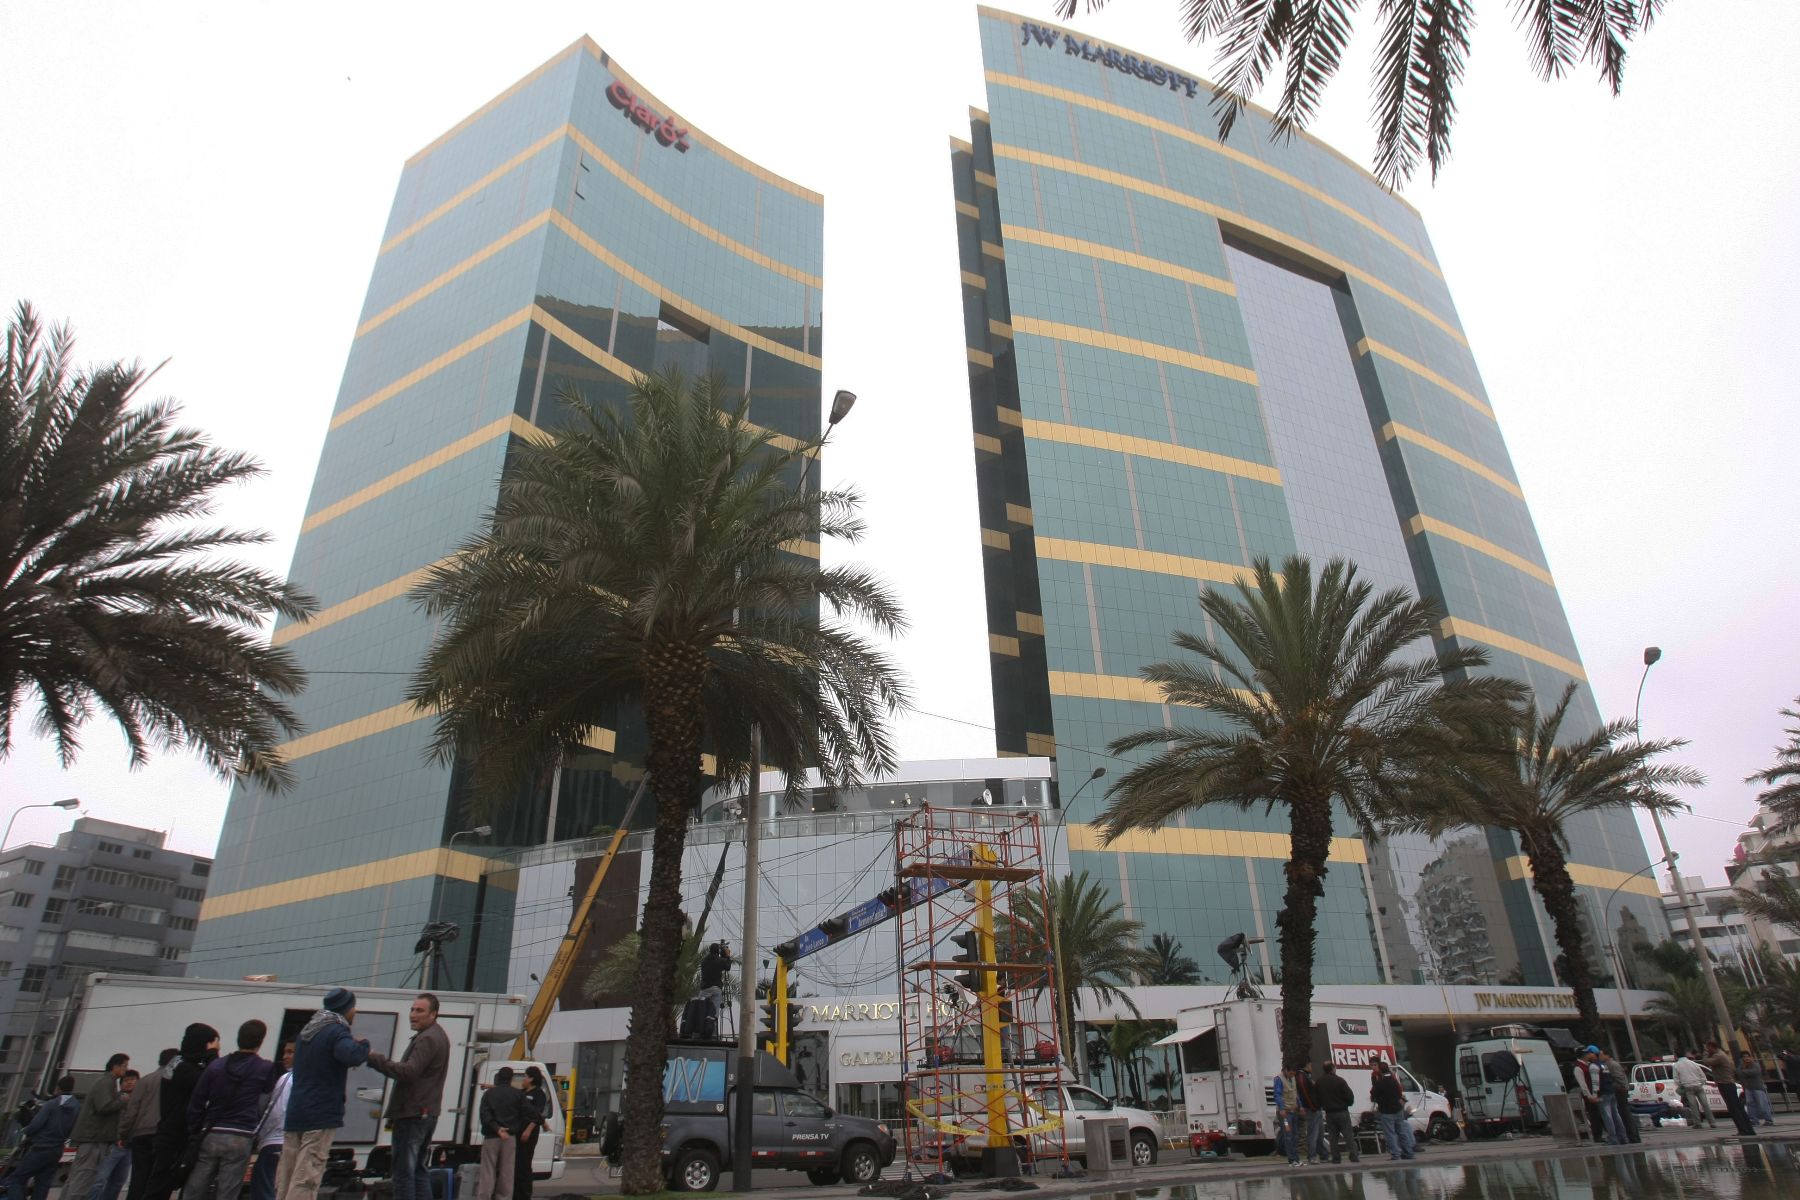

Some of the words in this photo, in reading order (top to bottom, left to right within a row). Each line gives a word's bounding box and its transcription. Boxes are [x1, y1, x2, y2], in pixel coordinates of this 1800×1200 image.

[1021, 22, 1059, 50] JW
[1062, 33, 1199, 99] MARRIOTT
[605, 79, 690, 154] Claro
[1331, 1048, 1392, 1066] RENSA
